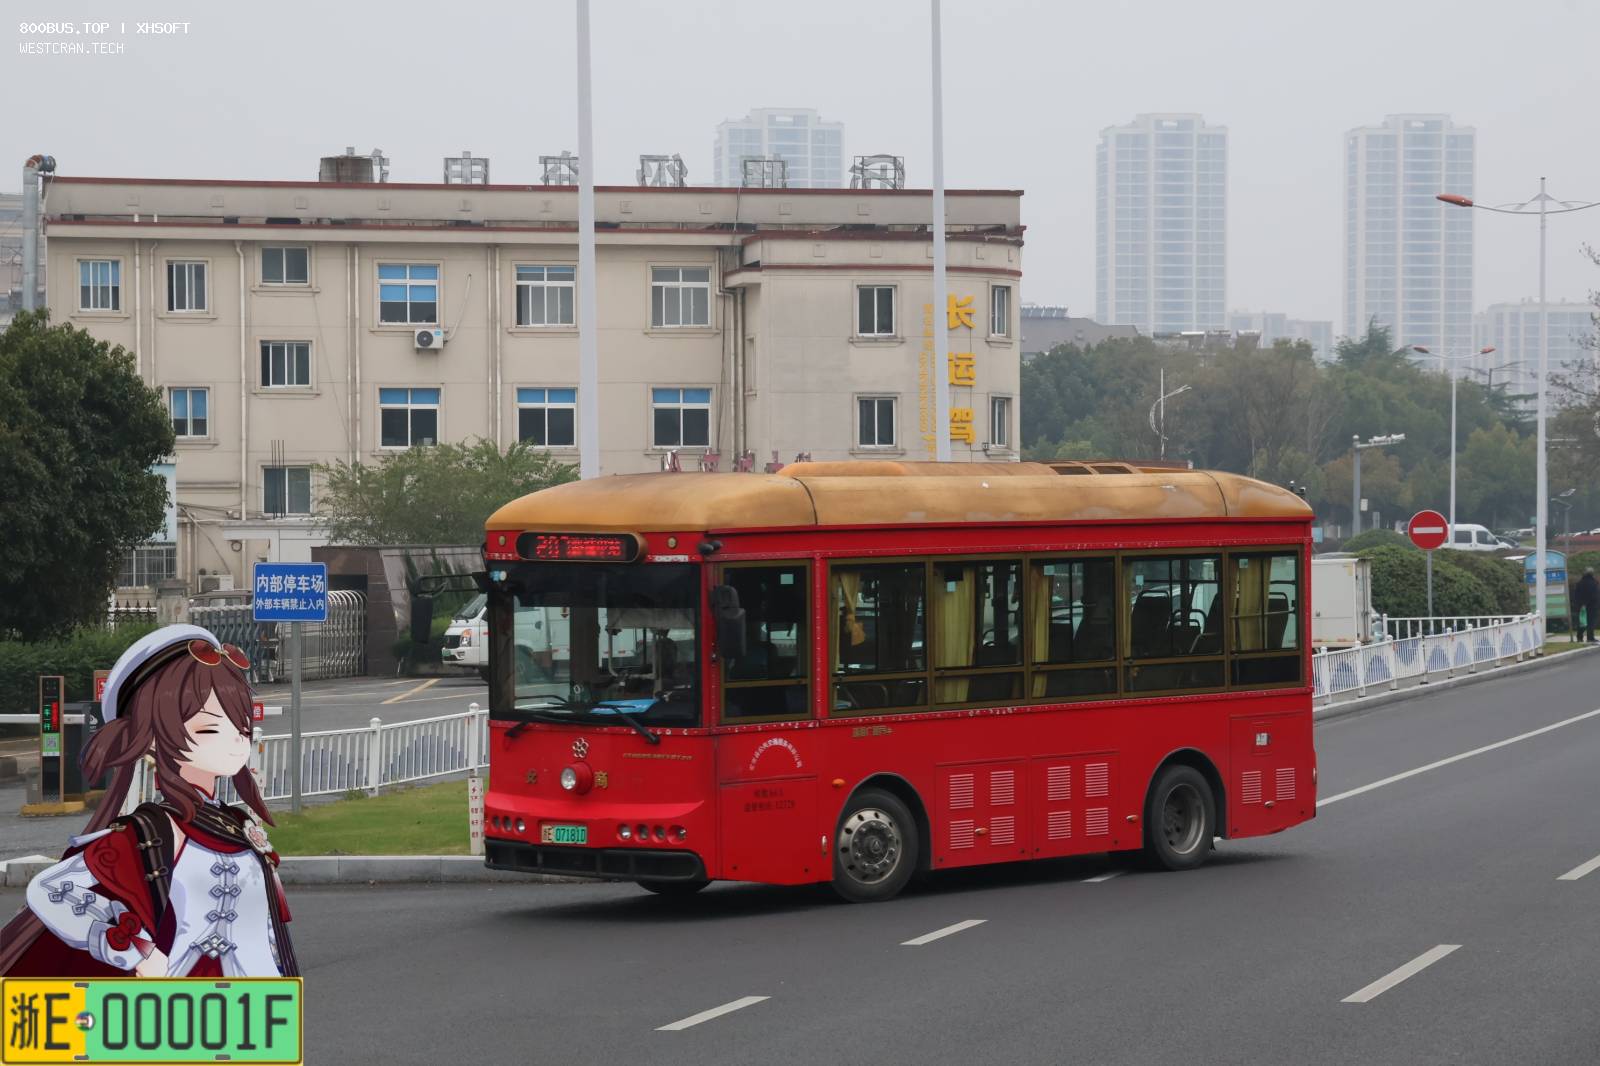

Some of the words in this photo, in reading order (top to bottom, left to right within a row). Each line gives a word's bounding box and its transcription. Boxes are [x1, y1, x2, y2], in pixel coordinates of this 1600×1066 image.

[256, 574, 325, 593] 内部停车场
[255, 597, 325, 610] 外部车辆禁止入内
